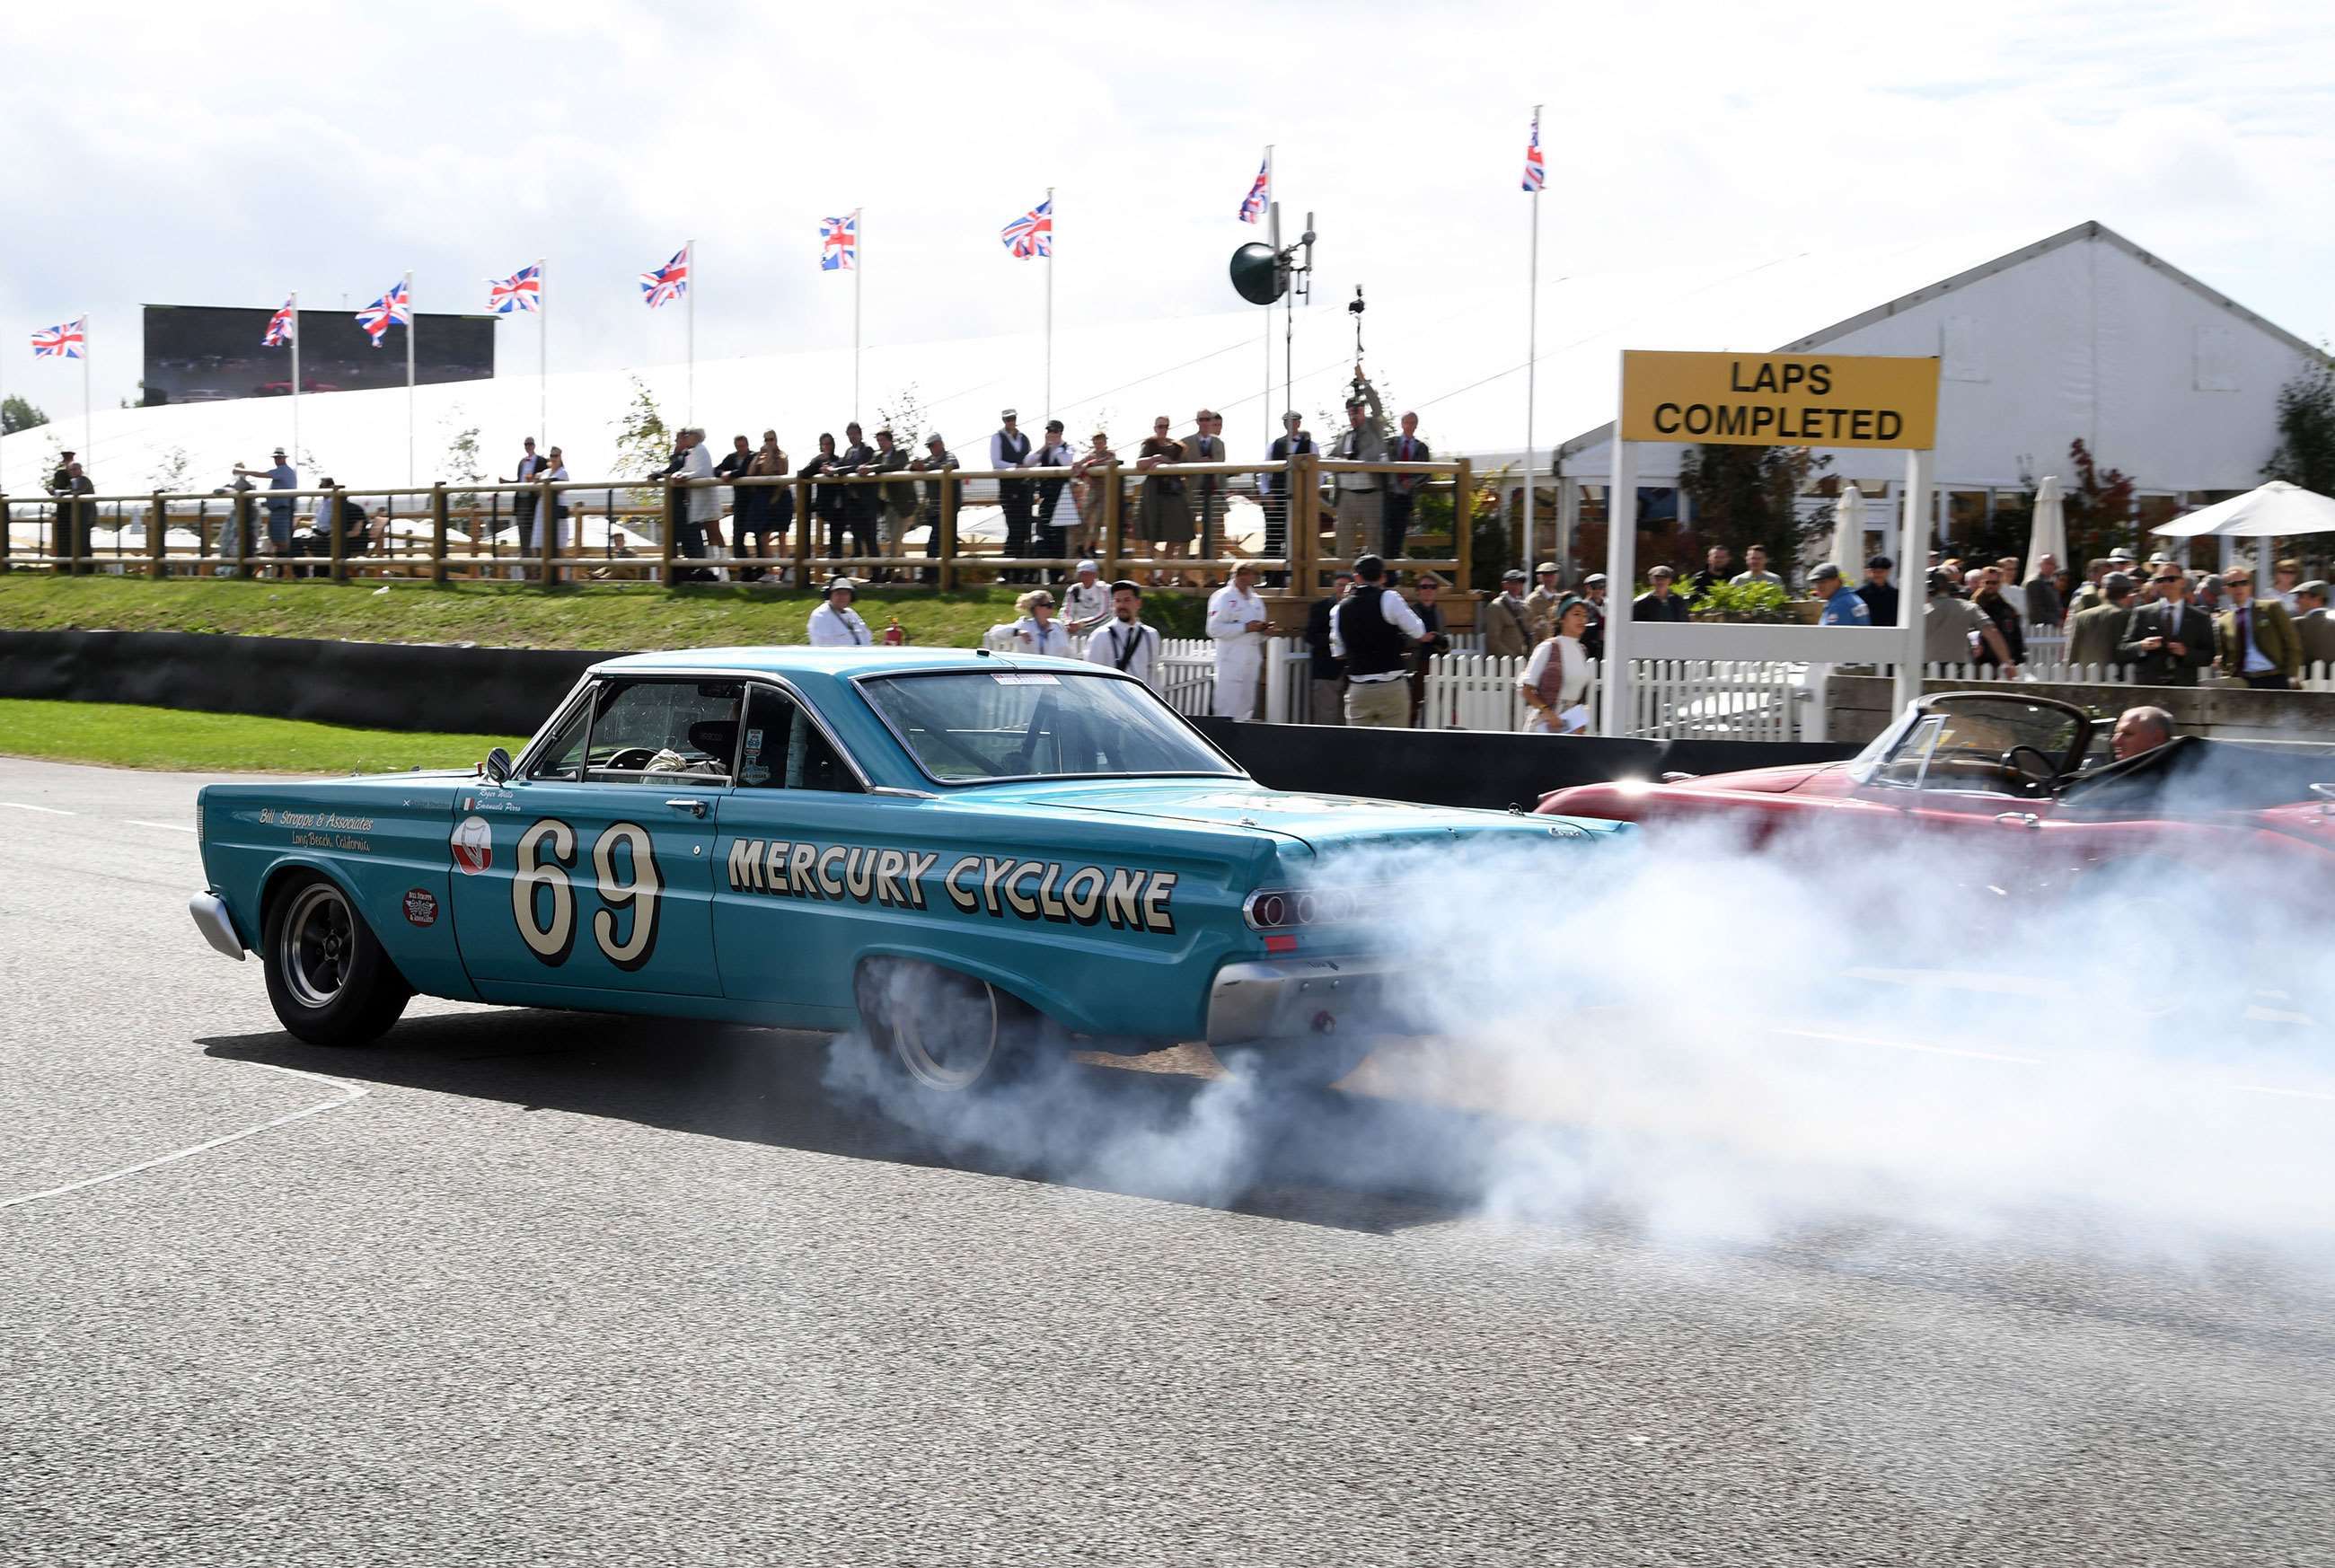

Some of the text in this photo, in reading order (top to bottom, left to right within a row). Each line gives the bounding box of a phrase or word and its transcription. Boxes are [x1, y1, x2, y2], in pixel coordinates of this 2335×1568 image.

[1731, 361, 1832, 396] LAPS
[1653, 402, 1903, 441] COMPLETED
[260, 808, 374, 831] Bill Stroppe & Associates
[292, 831, 307, 848] Long
[511, 815, 665, 972] 69
[727, 837, 1178, 936] MERCURY CYCLONE
